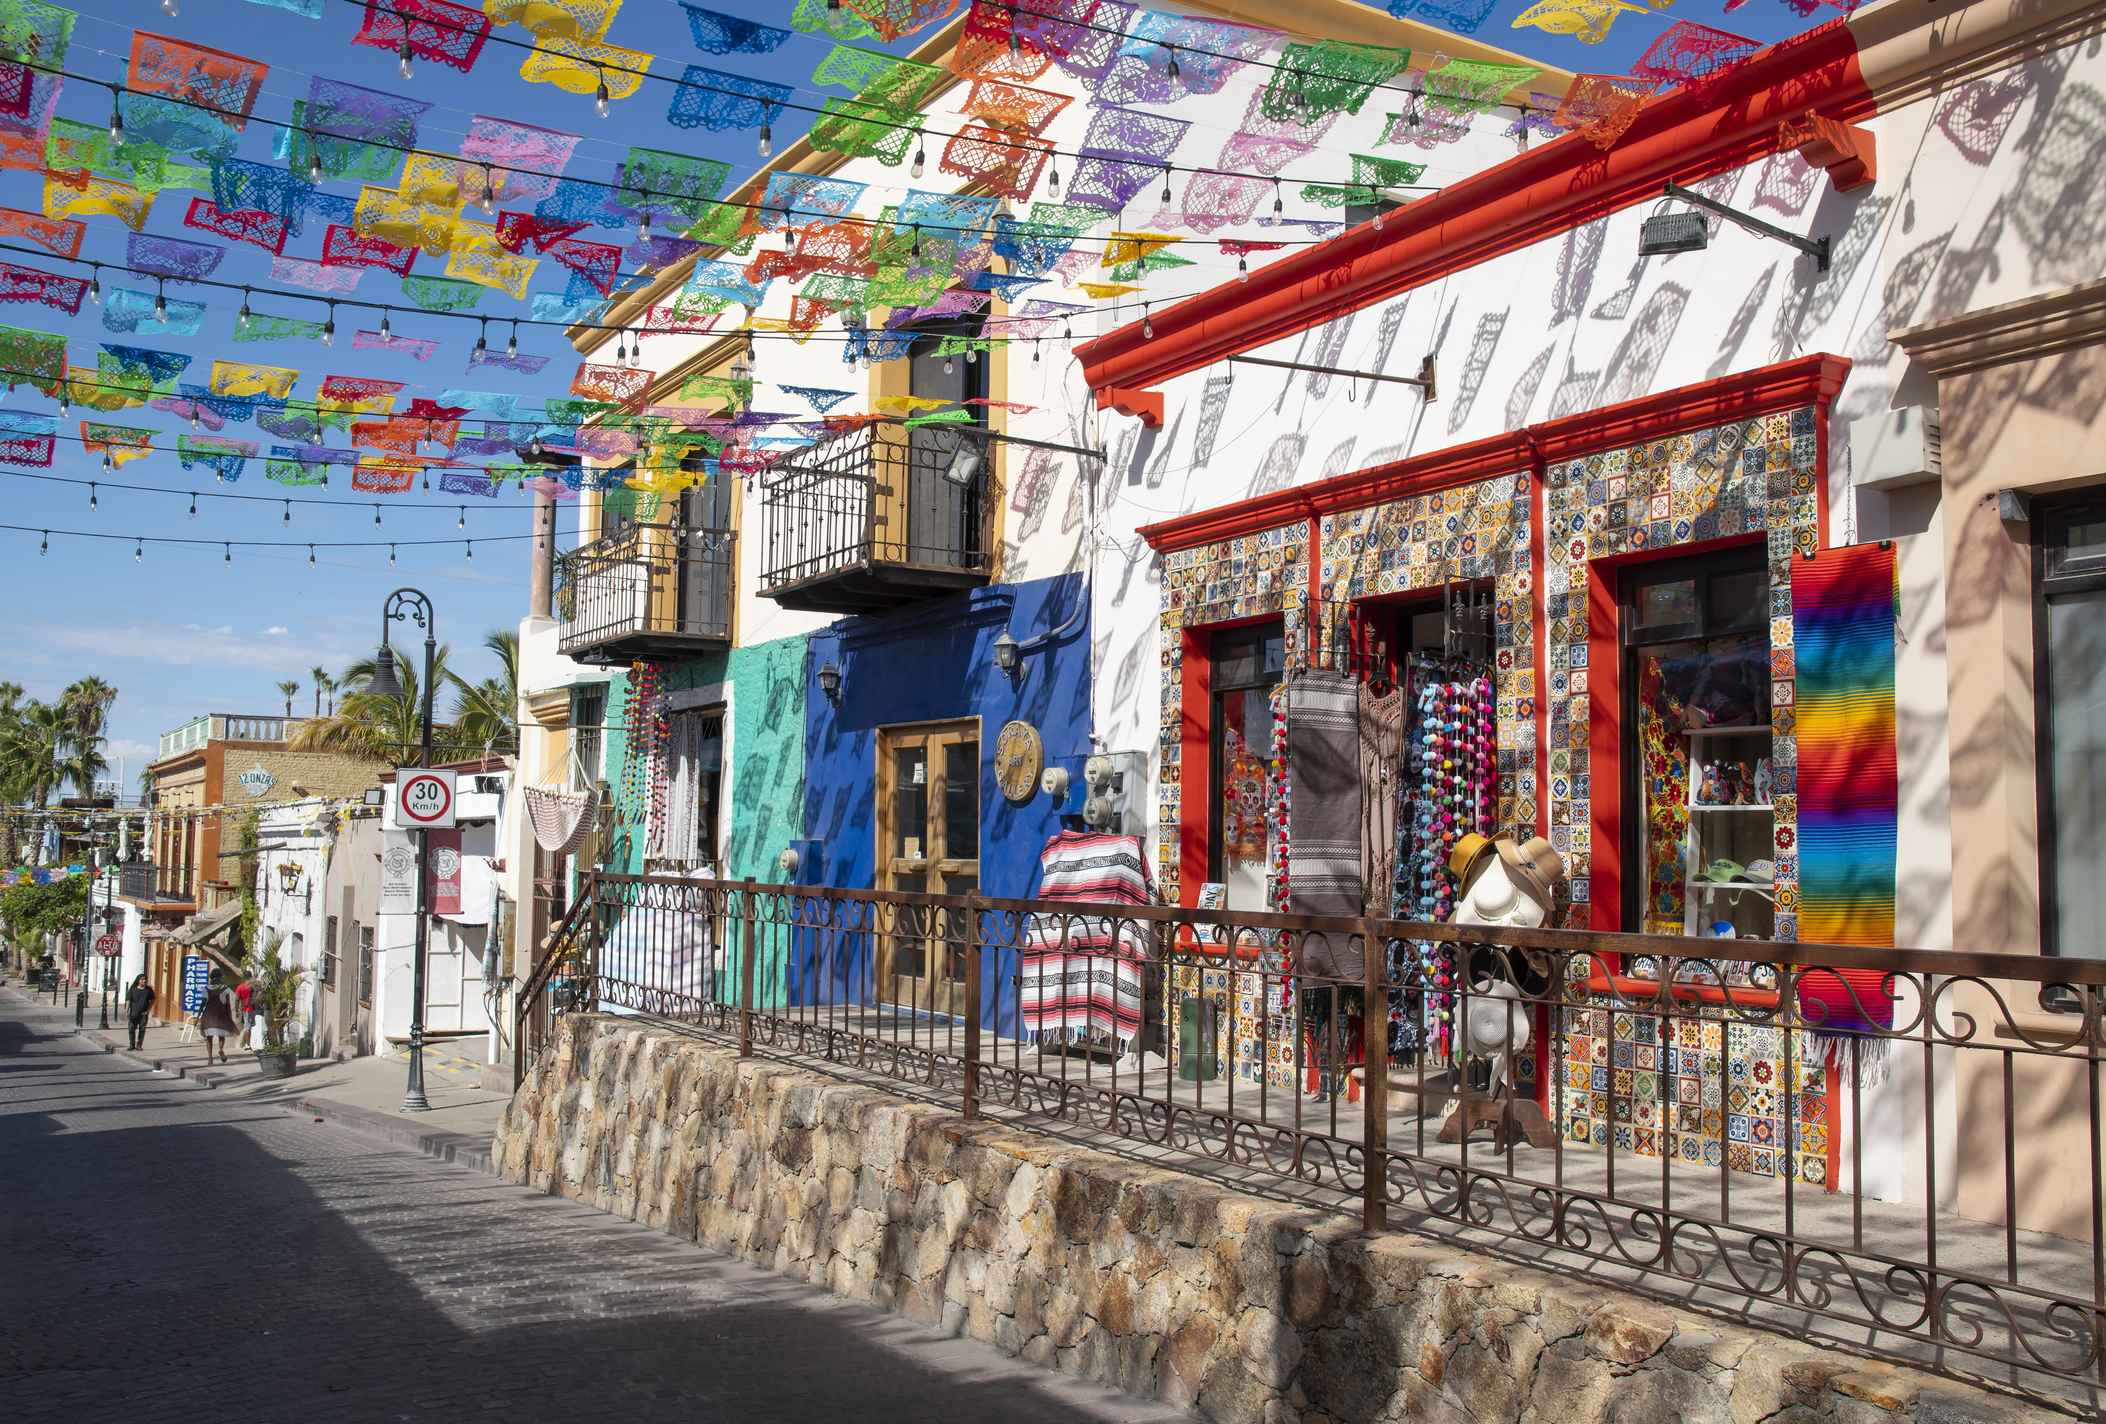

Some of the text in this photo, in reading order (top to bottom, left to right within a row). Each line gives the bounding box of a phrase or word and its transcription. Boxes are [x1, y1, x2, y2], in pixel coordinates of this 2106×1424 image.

[997, 724, 1032, 756] SORAYA
[1008, 755, 1023, 767] ART
[238, 773, 277, 788] 12 ONZAS
[997, 767, 1034, 798] GALLERY
[415, 782, 438, 800] 30
[412, 802, 439, 811] Km/h
[97, 941, 118, 950] ALTO
[184, 958, 196, 1009] PHARMACY
